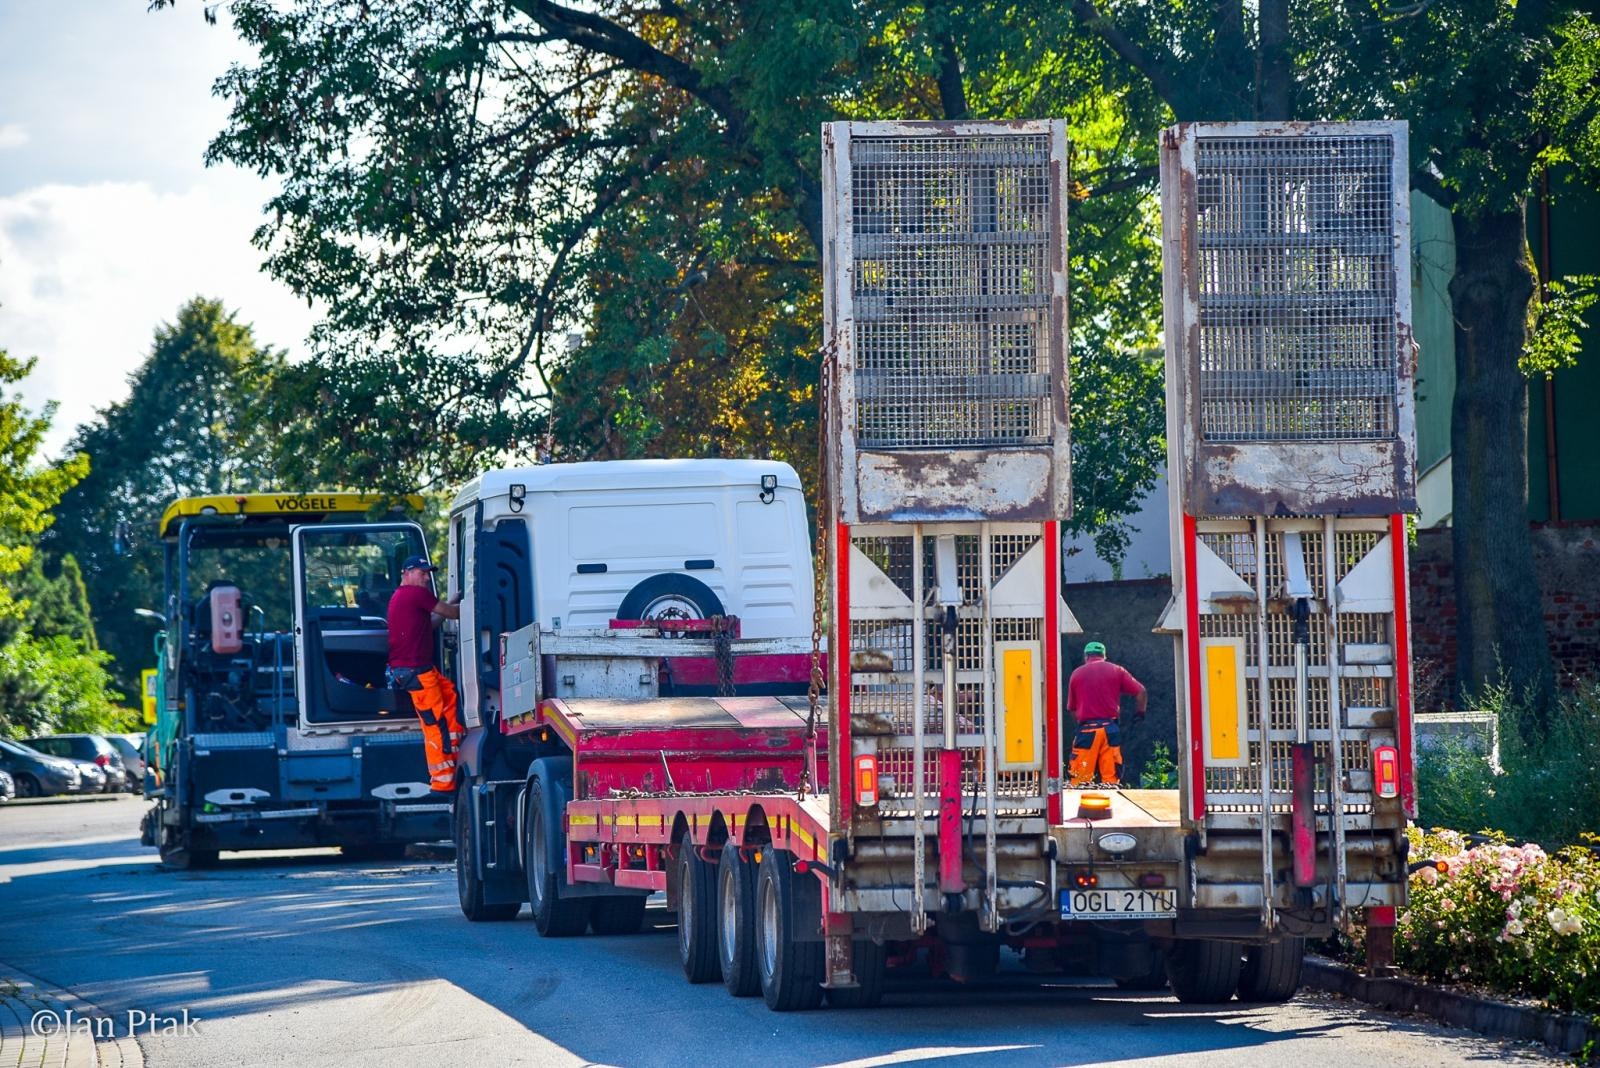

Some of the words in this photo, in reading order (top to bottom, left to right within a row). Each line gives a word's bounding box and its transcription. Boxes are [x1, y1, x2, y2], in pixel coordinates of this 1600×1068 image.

[275, 496, 337, 510] VÖGELE
[1073, 892, 1116, 912] OGL
[1123, 891, 1174, 912] 21YU
